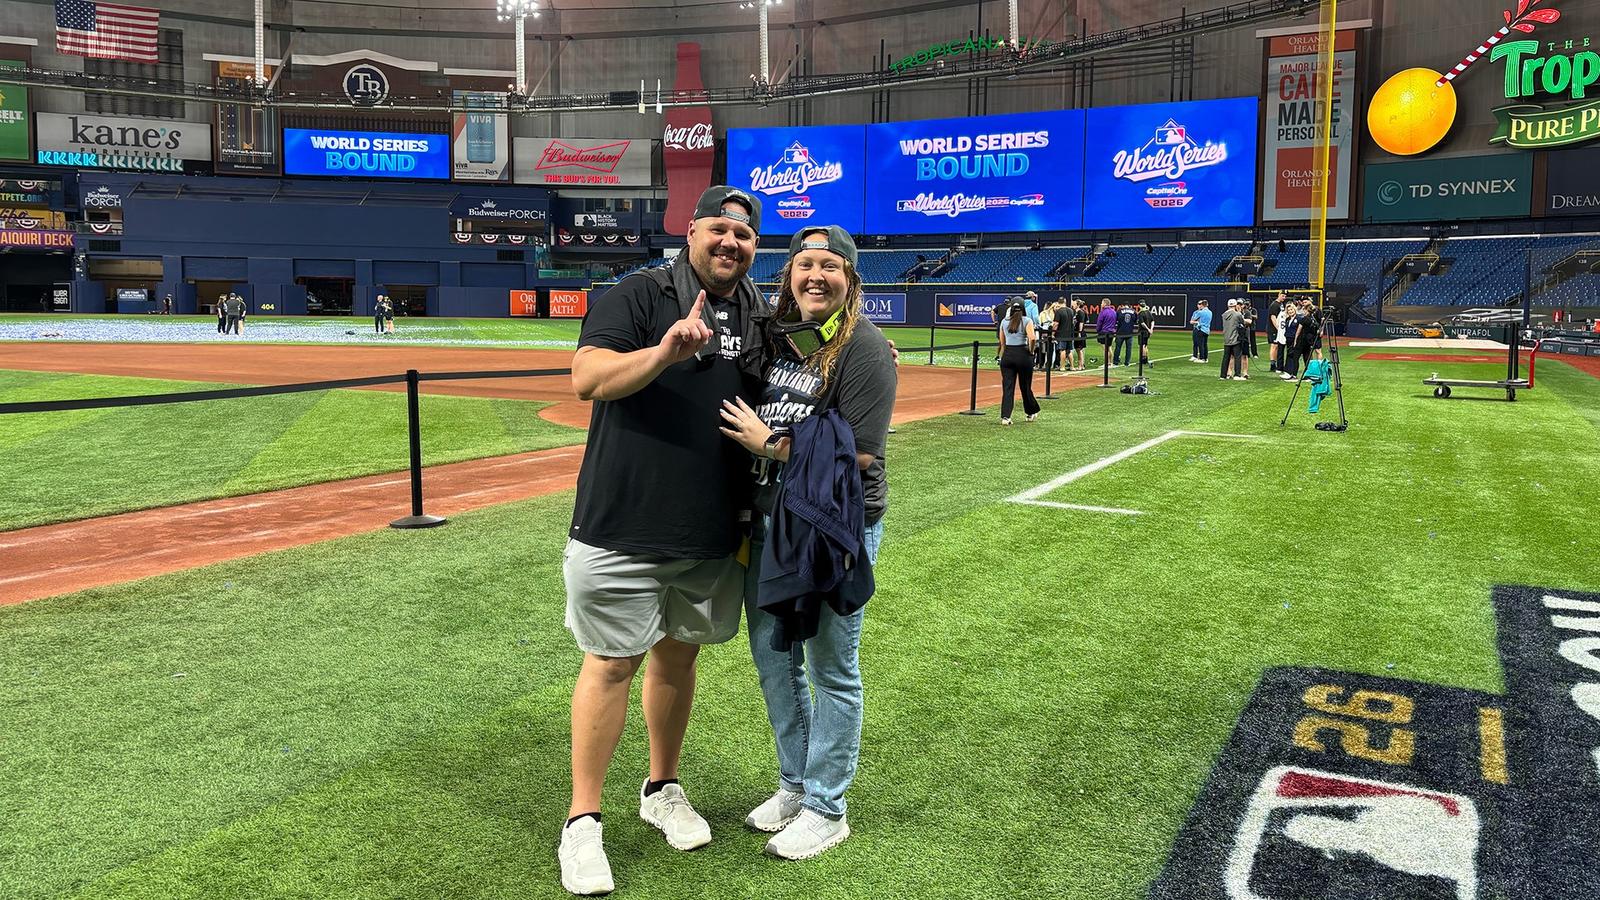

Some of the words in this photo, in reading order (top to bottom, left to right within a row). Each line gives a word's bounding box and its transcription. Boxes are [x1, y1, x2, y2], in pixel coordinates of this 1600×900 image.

[1547, 38, 1590, 51] THE
[889, 35, 1006, 74] TROPICANA
[1280, 63, 1309, 73] MAJOR
[1490, 40, 1600, 99] Trop
[68, 116, 182, 149] kane's
[664, 123, 714, 150] Coca-Cola
[1510, 116, 1574, 141] PURE
[310, 136, 370, 150] WORLD
[373, 138, 429, 152] SERIES
[900, 136, 972, 155] WORLD
[975, 130, 1049, 151] SERIES
[81, 147, 172, 158] FURNITURE
[546, 147, 620, 163] Budweiser
[326, 151, 416, 172] BOUND
[916, 152, 1030, 181] BOUND
[543, 174, 561, 183] THIS
[563, 174, 586, 183] BUD'S
[587, 175, 602, 183] FOR
[1409, 184, 1432, 198] TD
[1438, 178, 1517, 197] SYNNEX
[84, 197, 121, 206] PORCH
[1152, 199, 1183, 207] 2026
[509, 209, 546, 220] PORCH
[44, 233, 74, 247] DECK
[1451, 329, 1492, 337] NUTRAFOL
